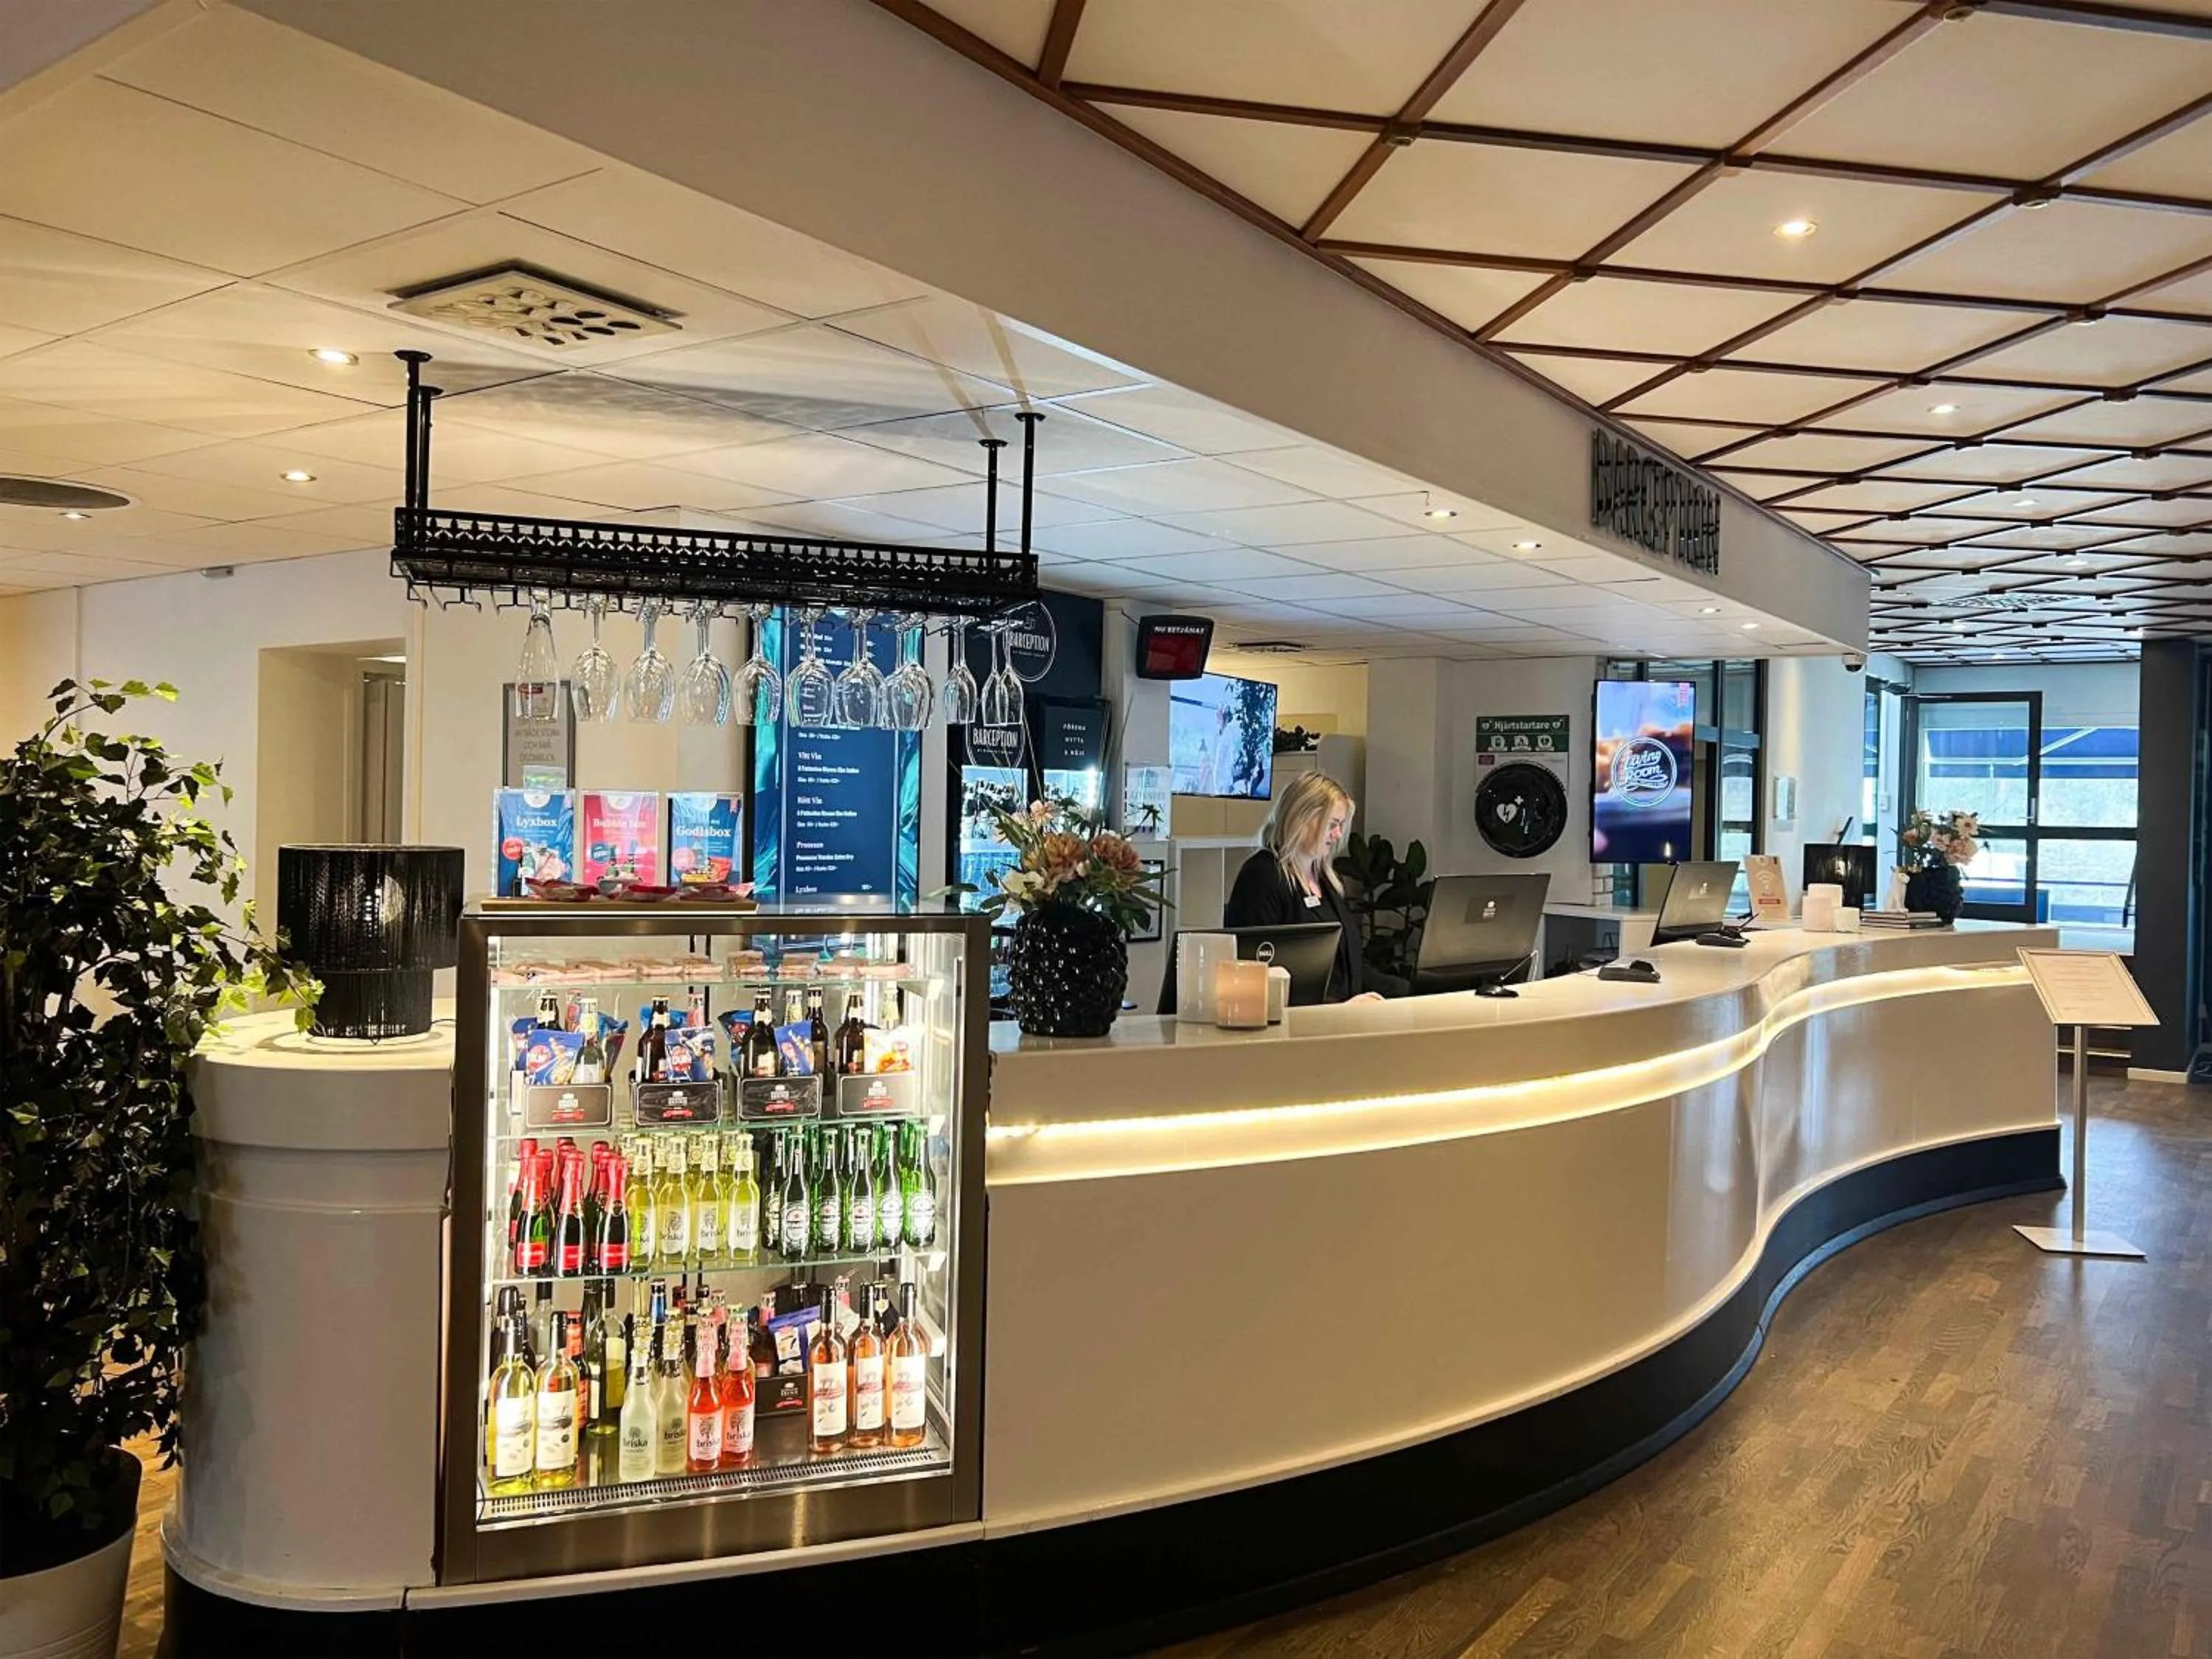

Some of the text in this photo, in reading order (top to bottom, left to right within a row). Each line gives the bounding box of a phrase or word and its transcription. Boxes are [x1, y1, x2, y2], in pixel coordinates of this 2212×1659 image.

[1495, 720, 1549, 731] Hjärtstartare
[973, 728, 1018, 748] BARCEPTION
[1624, 750, 1662, 769] Living
[1624, 765, 1663, 783] Room
[516, 815, 558, 828] Lyxbox
[676, 826, 731, 838] Godisbox
[623, 1438, 648, 1447] briska
